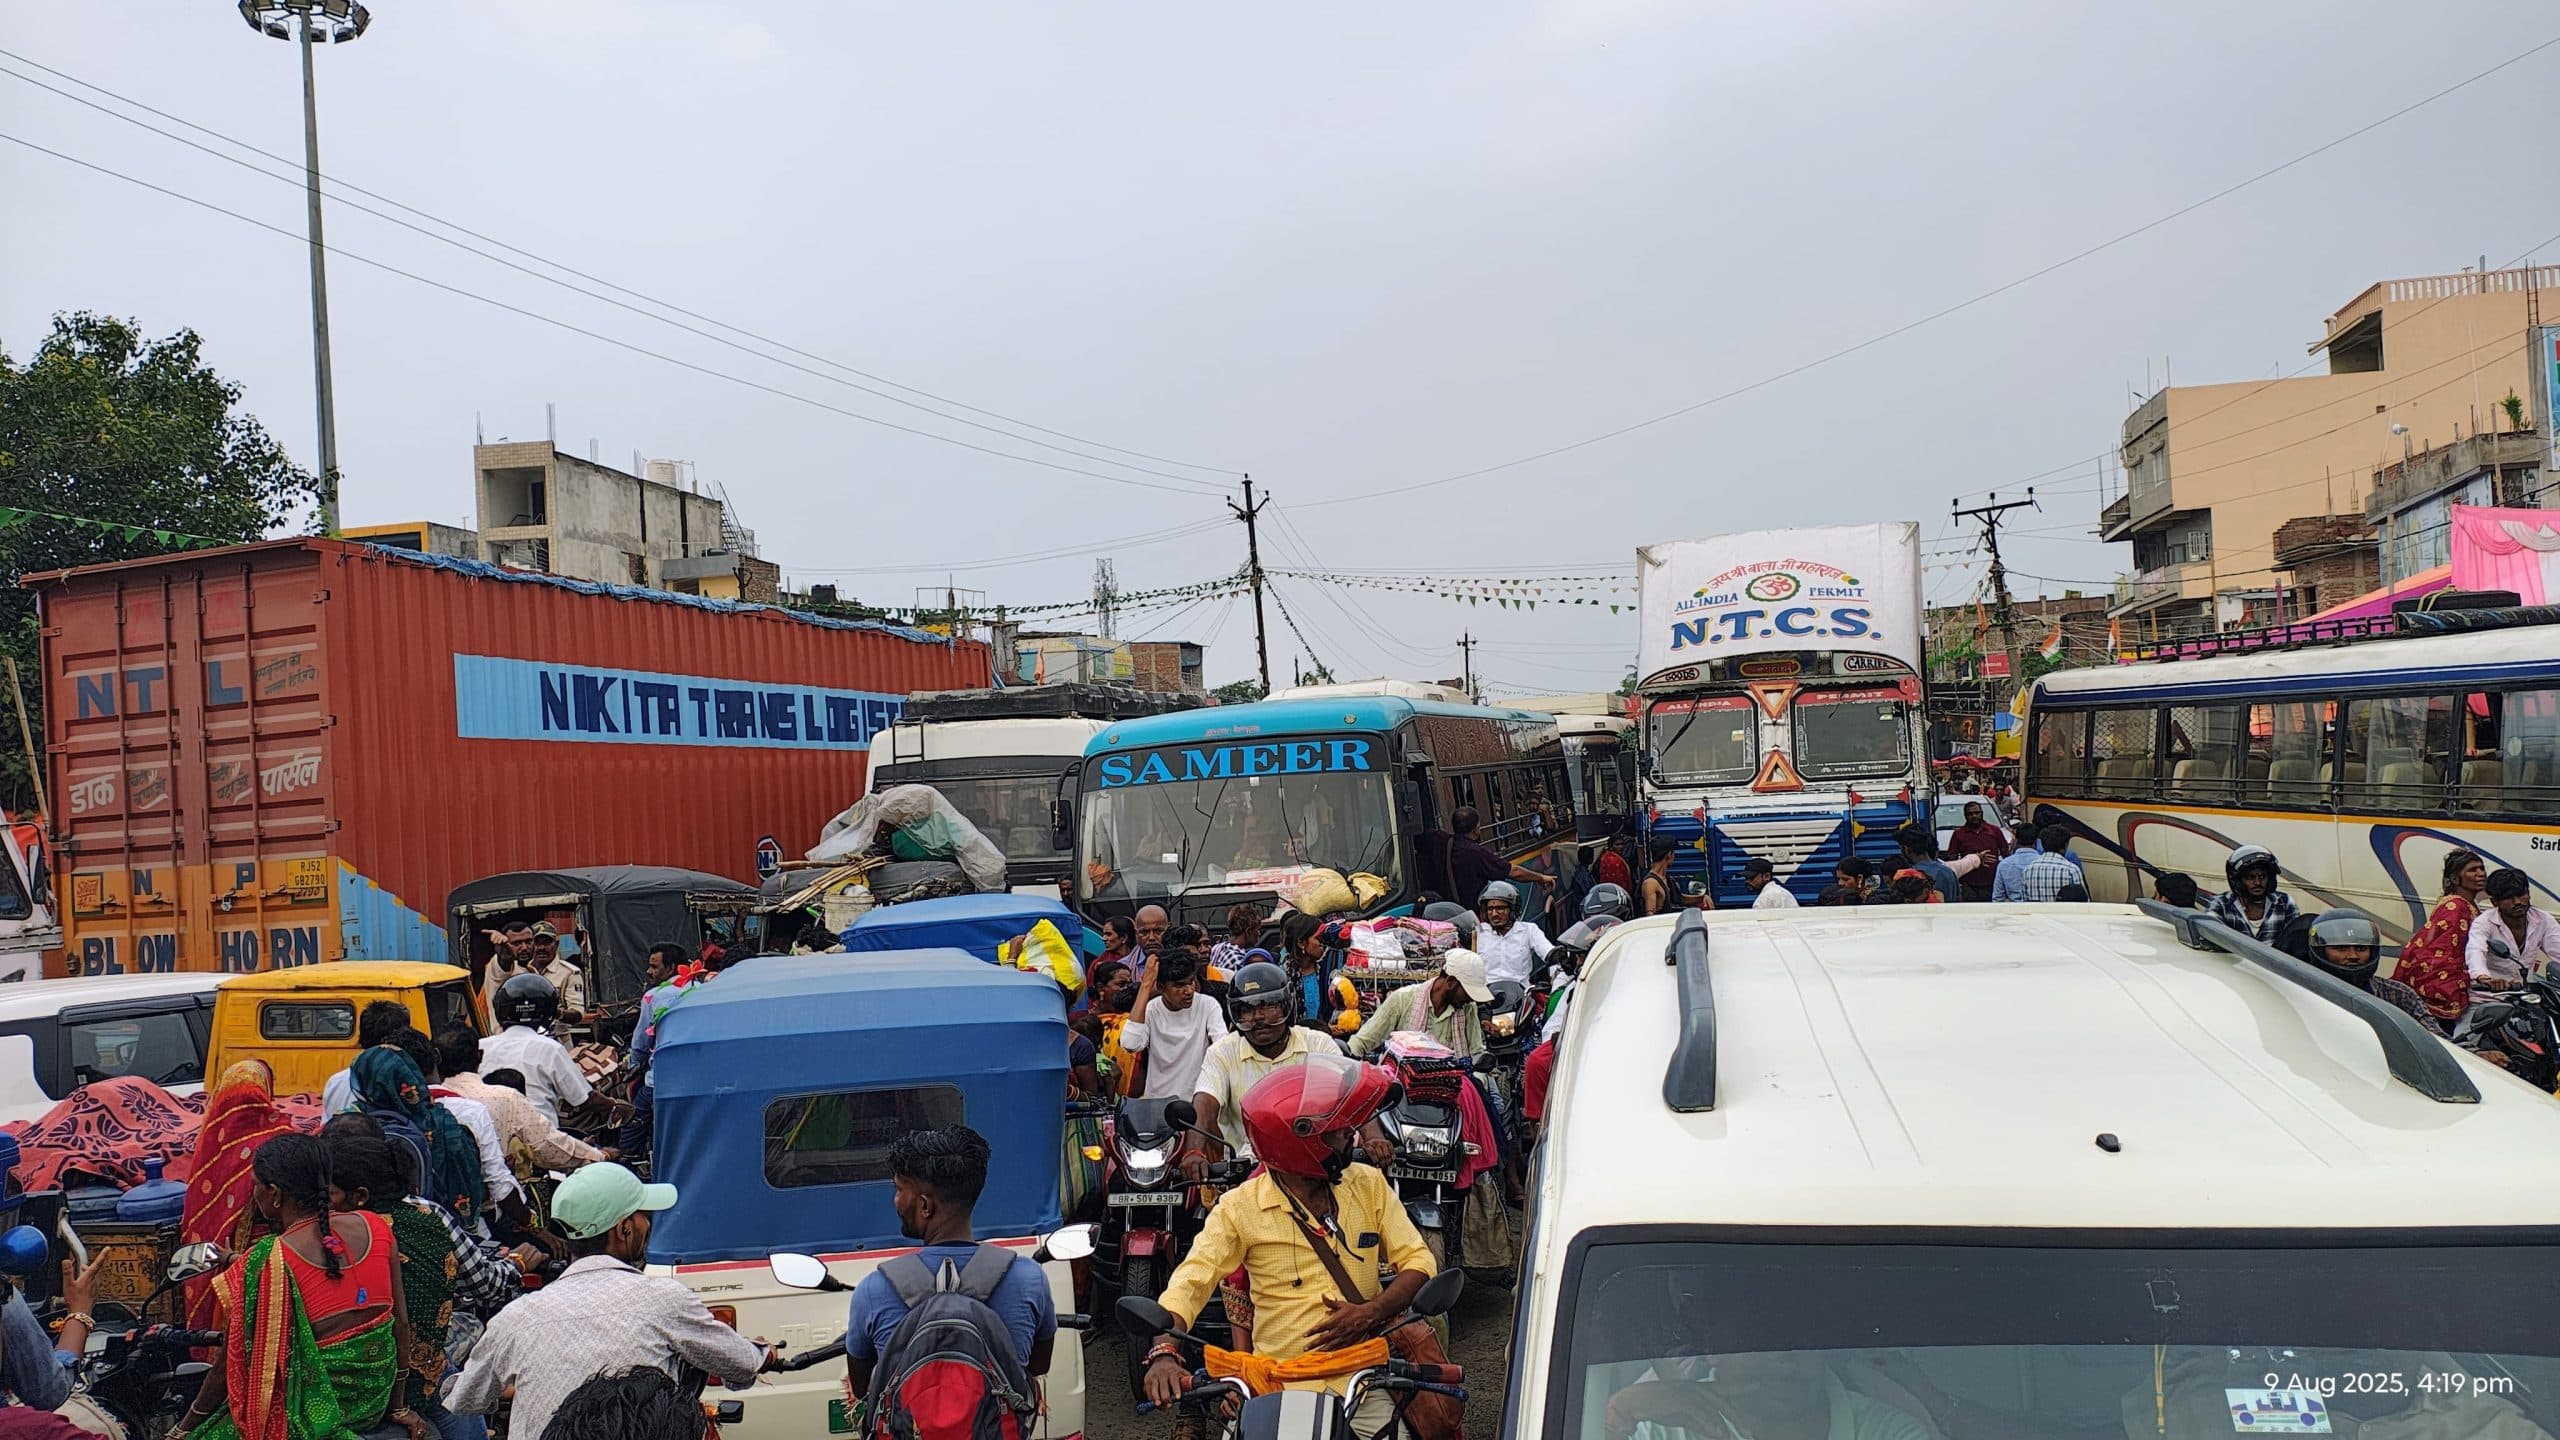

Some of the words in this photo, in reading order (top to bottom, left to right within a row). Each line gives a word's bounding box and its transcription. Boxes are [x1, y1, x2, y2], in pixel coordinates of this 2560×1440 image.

[1707, 571, 1732, 590] जय
[1748, 560, 1778, 575] बाला
[1796, 560, 1847, 580] महाराज
[1809, 587, 1865, 598] PERMIT
[1669, 606, 1884, 650] N.T.C.S.
[1847, 656, 1889, 668] CARRIER
[1665, 669, 1696, 681] GOODS
[539, 670, 681, 736] NIKITA
[1101, 740, 1371, 788] SAMEER
[2530, 836, 2560, 851] Star
[300, 861, 321, 872] RJ52
